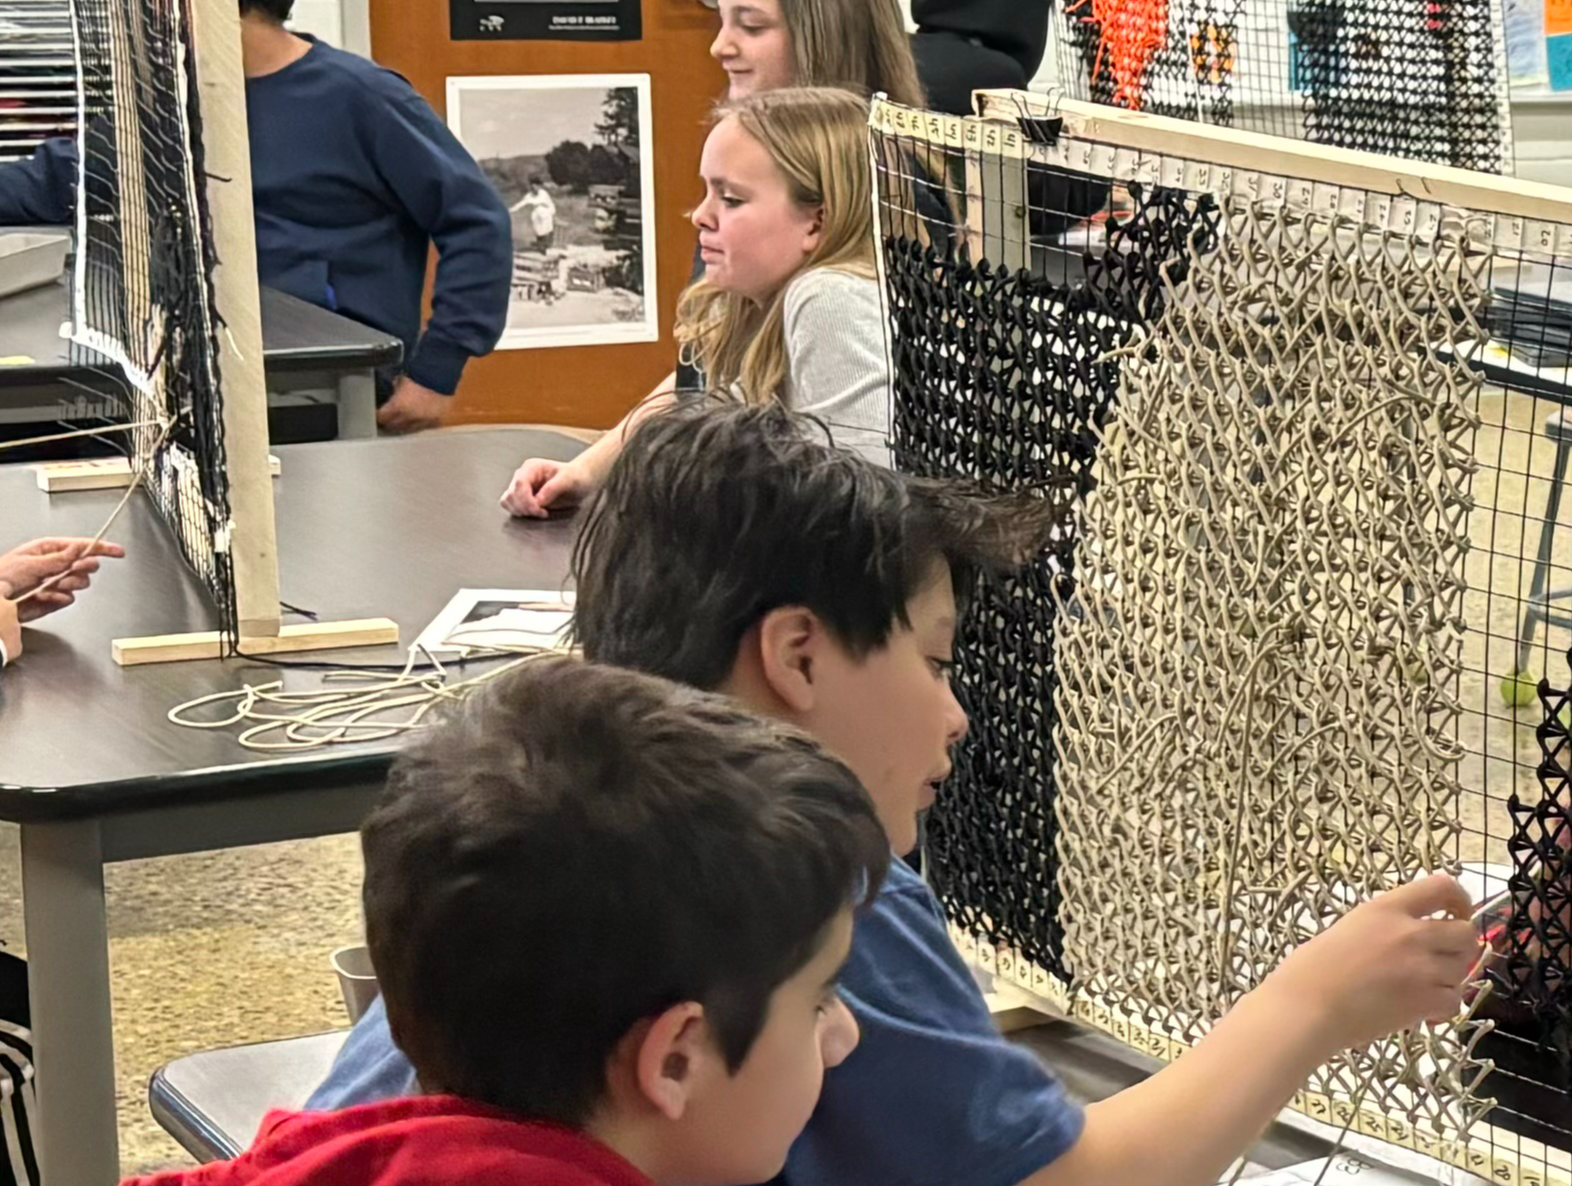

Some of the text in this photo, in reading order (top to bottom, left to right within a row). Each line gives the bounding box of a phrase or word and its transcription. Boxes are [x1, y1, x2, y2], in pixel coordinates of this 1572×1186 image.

[928, 118, 941, 138] 45
[966, 124, 980, 143] 43
[986, 129, 997, 148] 42
[1004, 133, 1016, 148] 41
[1540, 230, 1551, 247] 20
[1363, 1115, 1384, 1132] 25
[1493, 1165, 1511, 1182] 20
